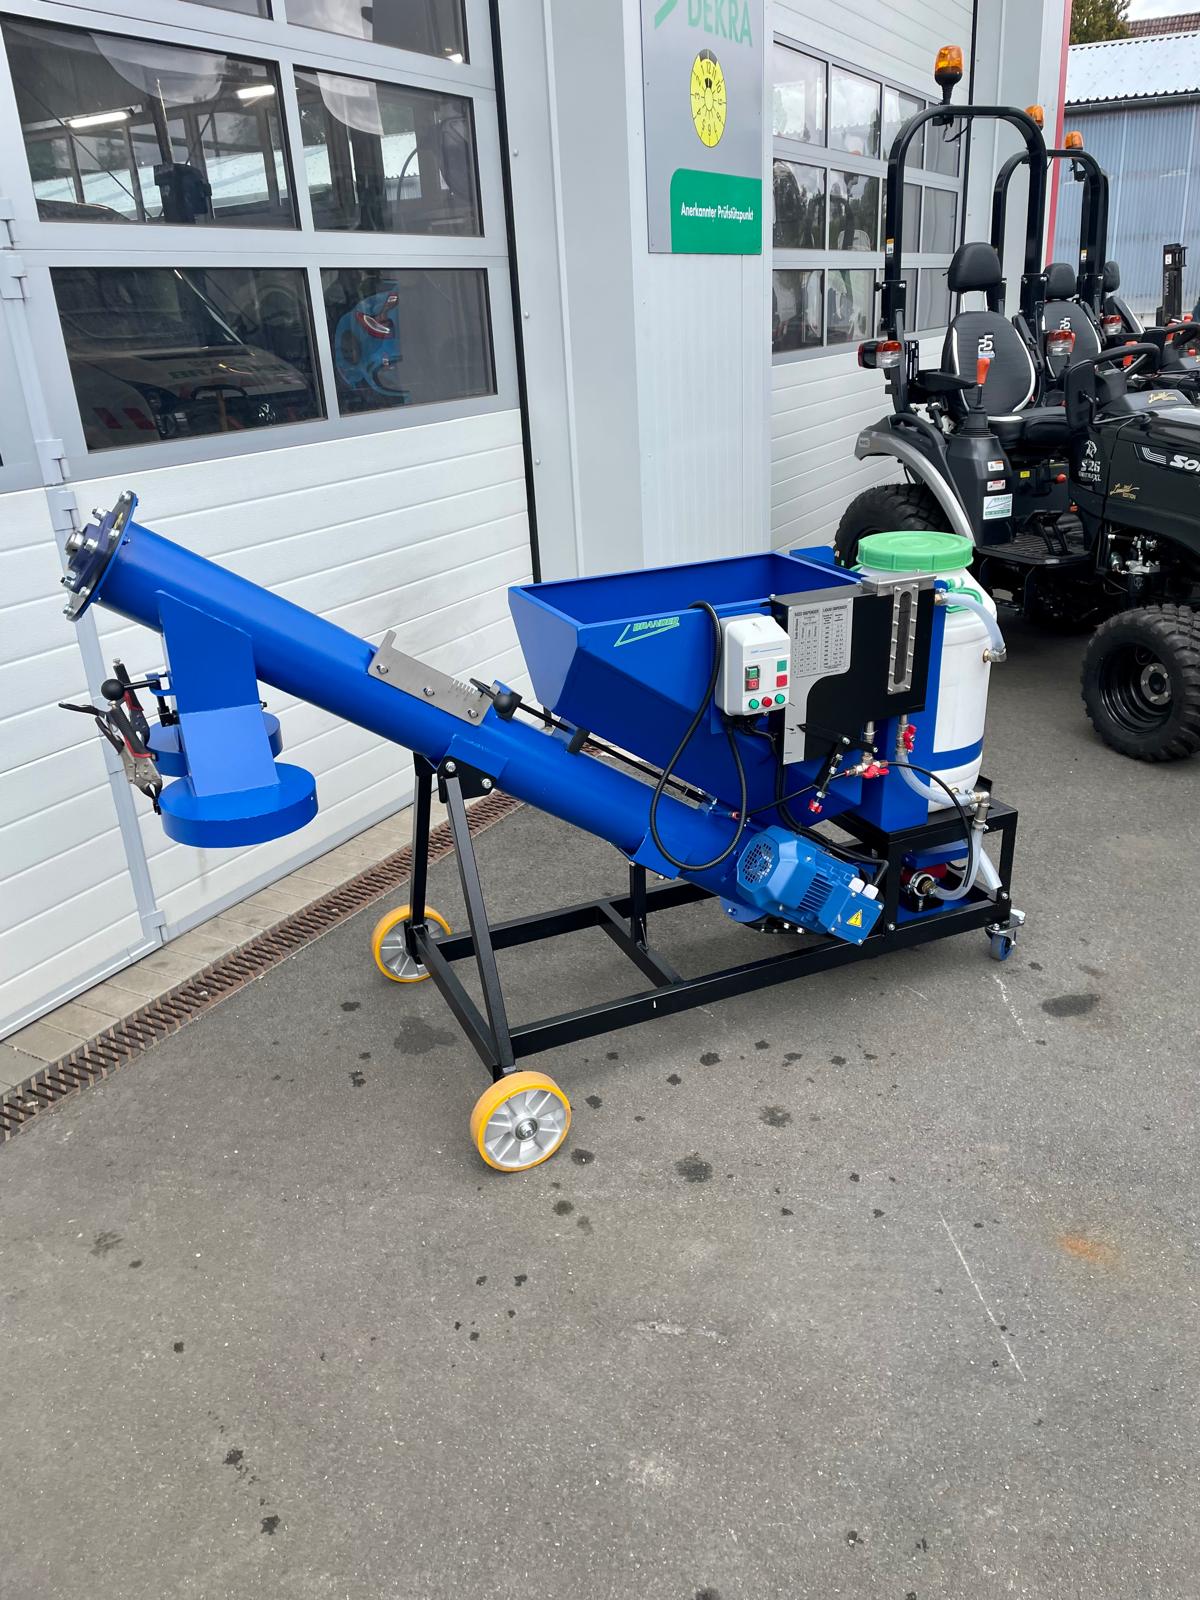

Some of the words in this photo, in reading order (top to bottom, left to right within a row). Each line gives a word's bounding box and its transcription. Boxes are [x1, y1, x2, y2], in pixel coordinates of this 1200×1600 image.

[688, 0, 752, 48] DEKRA
[706, 61, 711, 75] 12
[712, 66, 717, 80] 11
[716, 81, 721, 93] 10
[681, 201, 717, 218] Anerkannter
[717, 204, 754, 223] Prüfstützpunkt
